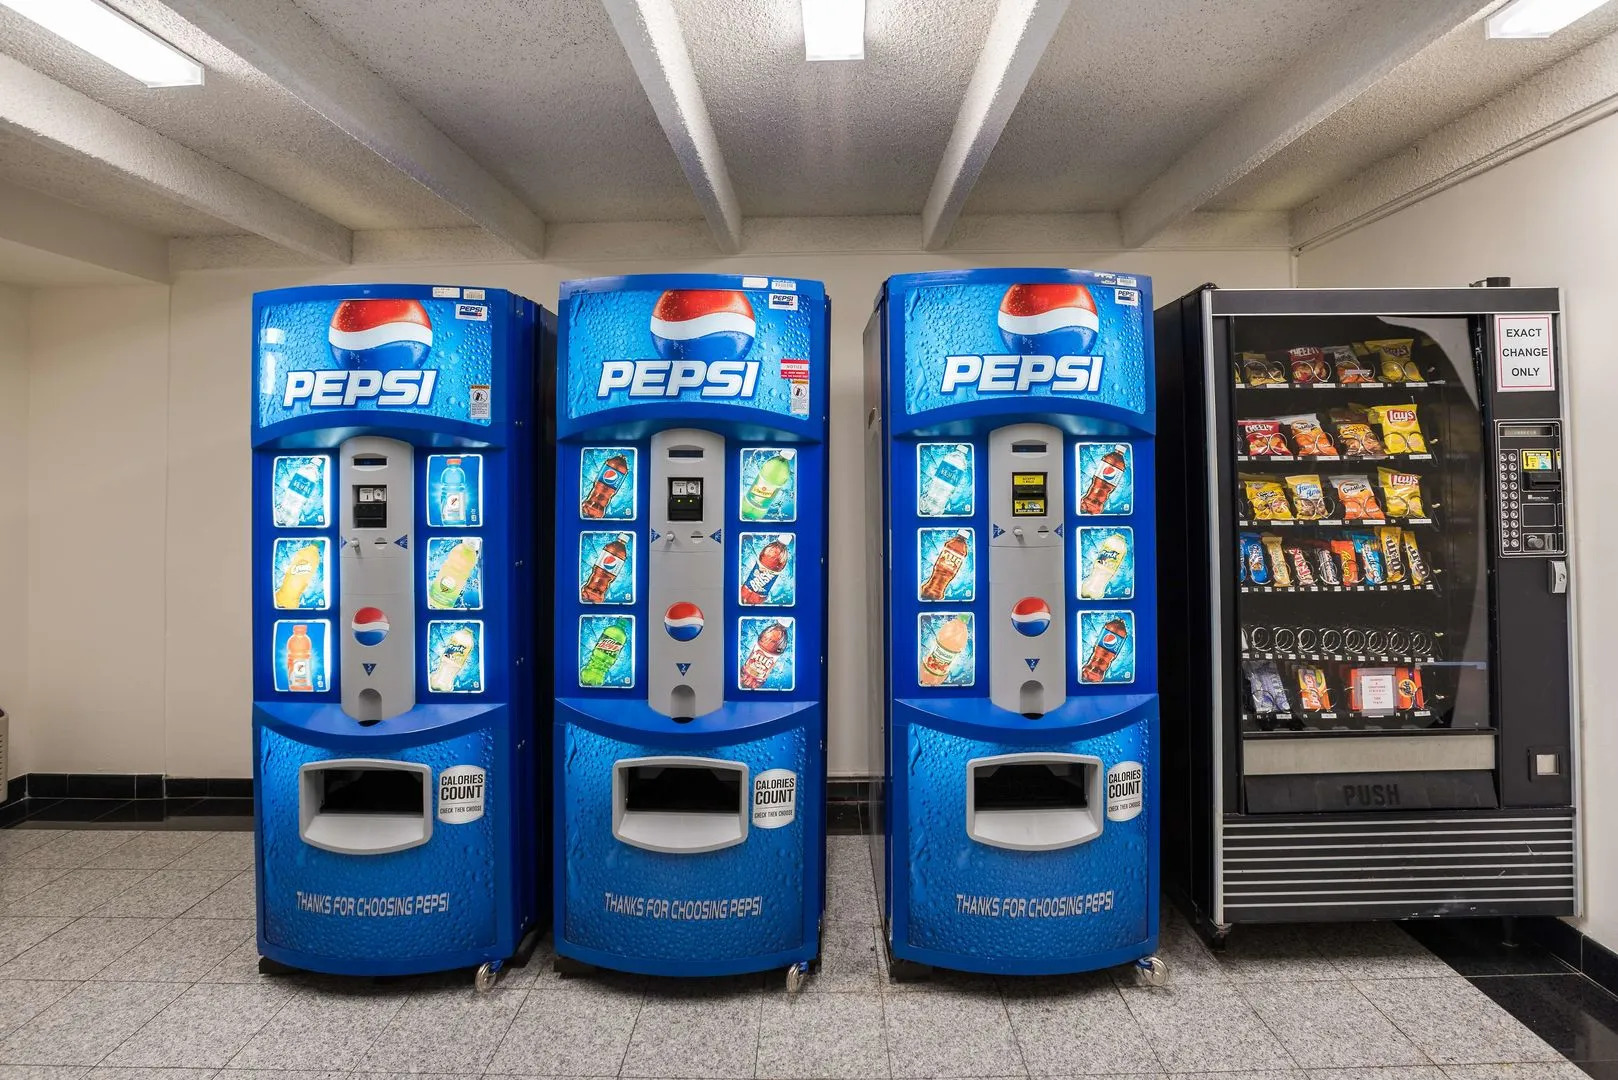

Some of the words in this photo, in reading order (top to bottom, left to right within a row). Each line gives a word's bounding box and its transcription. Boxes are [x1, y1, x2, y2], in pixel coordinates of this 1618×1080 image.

[459, 305, 483, 313] PEPSI
[1506, 328, 1542, 337] EXACT
[1502, 348, 1548, 357] CHANGE
[597, 360, 760, 398] PEPSI
[940, 355, 1104, 392] PEPSI
[1511, 367, 1540, 377] ONLY
[283, 369, 437, 408] PEPSI
[751, 652, 772, 667] MUG
[440, 773, 484, 786] CALORIES
[755, 778, 795, 790] CALORIES
[1108, 770, 1141, 784] CALORIES
[440, 785, 483, 801] COUNT
[755, 789, 794, 805] COUNT
[1108, 781, 1140, 799] COUNT
[1342, 784, 1401, 806] PUSH
[1108, 805, 1119, 813] CHECK
[296, 891, 331, 914] THANKS
[333, 897, 355, 915] FOR
[357, 897, 412, 917] CHOOSING
[415, 892, 450, 913] PEPSI
[605, 892, 643, 915] THANKS
[645, 899, 670, 919] FOR
[671, 899, 728, 920] CHOOSING
[729, 896, 763, 917] PEPSI
[956, 893, 999, 916] THANKS
[1001, 898, 1026, 918] FOR
[1027, 897, 1083, 918] CHOOSING
[1084, 892, 1114, 913] PEPSI
